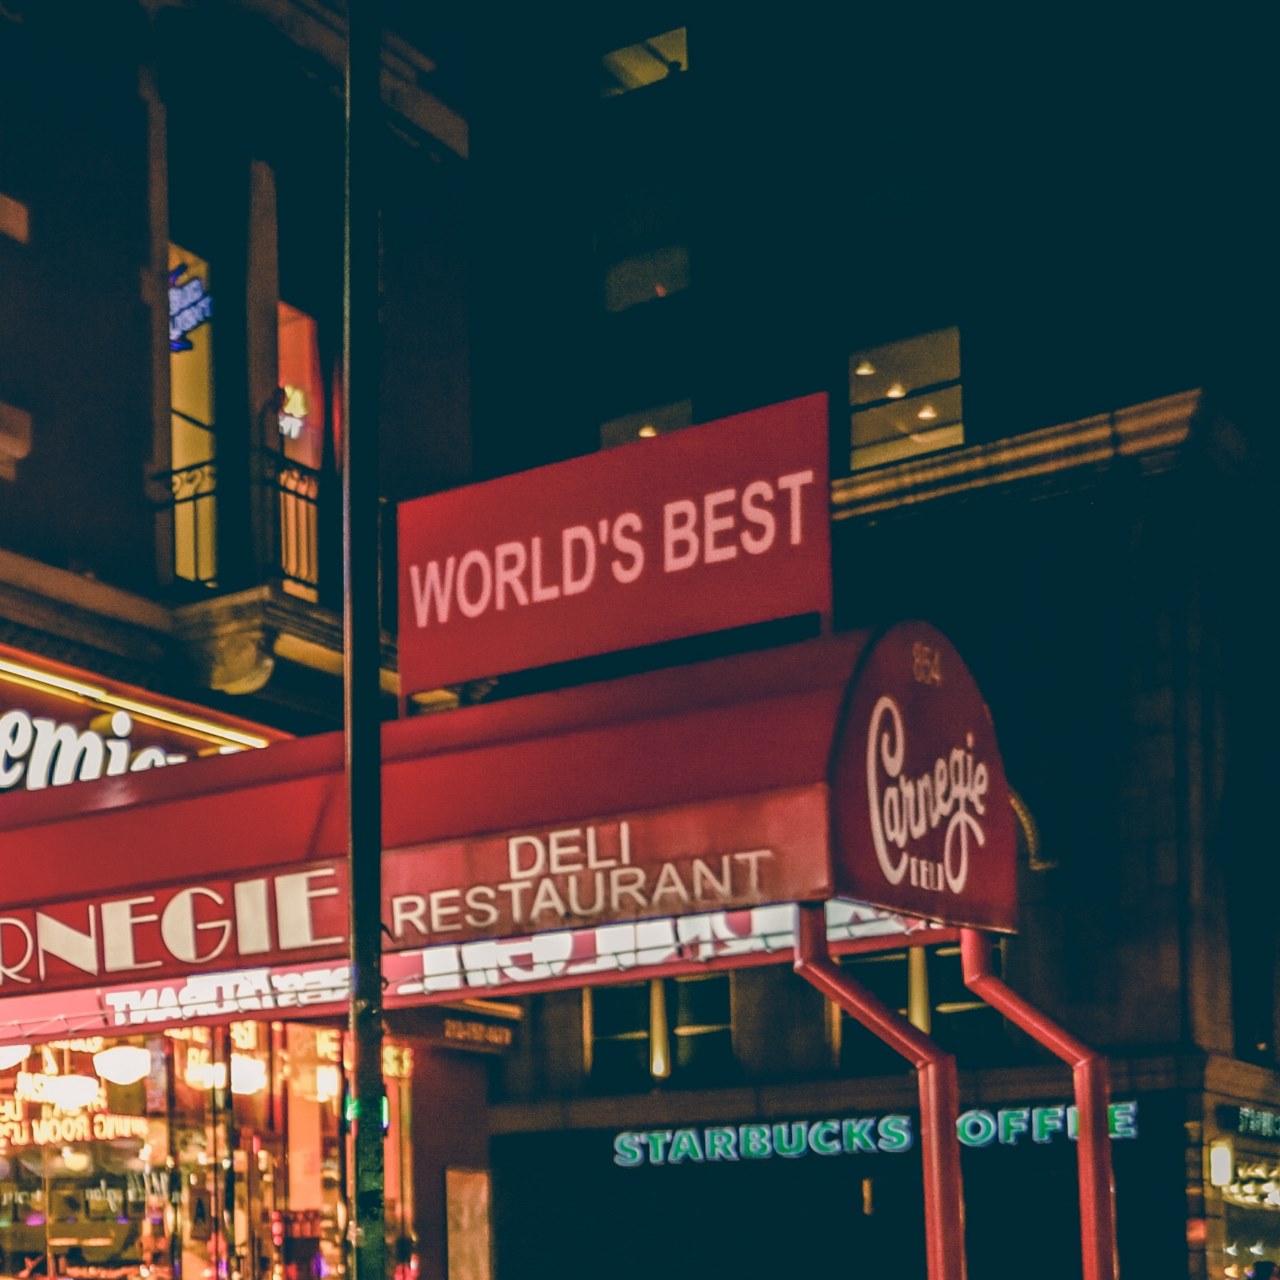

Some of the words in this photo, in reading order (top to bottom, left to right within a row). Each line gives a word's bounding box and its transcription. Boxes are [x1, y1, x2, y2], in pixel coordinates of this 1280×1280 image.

[409, 511, 645, 628] WORLD'S
[663, 469, 815, 575] BEST
[866, 694, 990, 895] Carnegie
[391, 848, 773, 937] RESTAURANT
[507, 821, 631, 882] DELI
[613, 1113, 913, 1168] STARBUCKS
[956, 1100, 1138, 1148] OFFE
